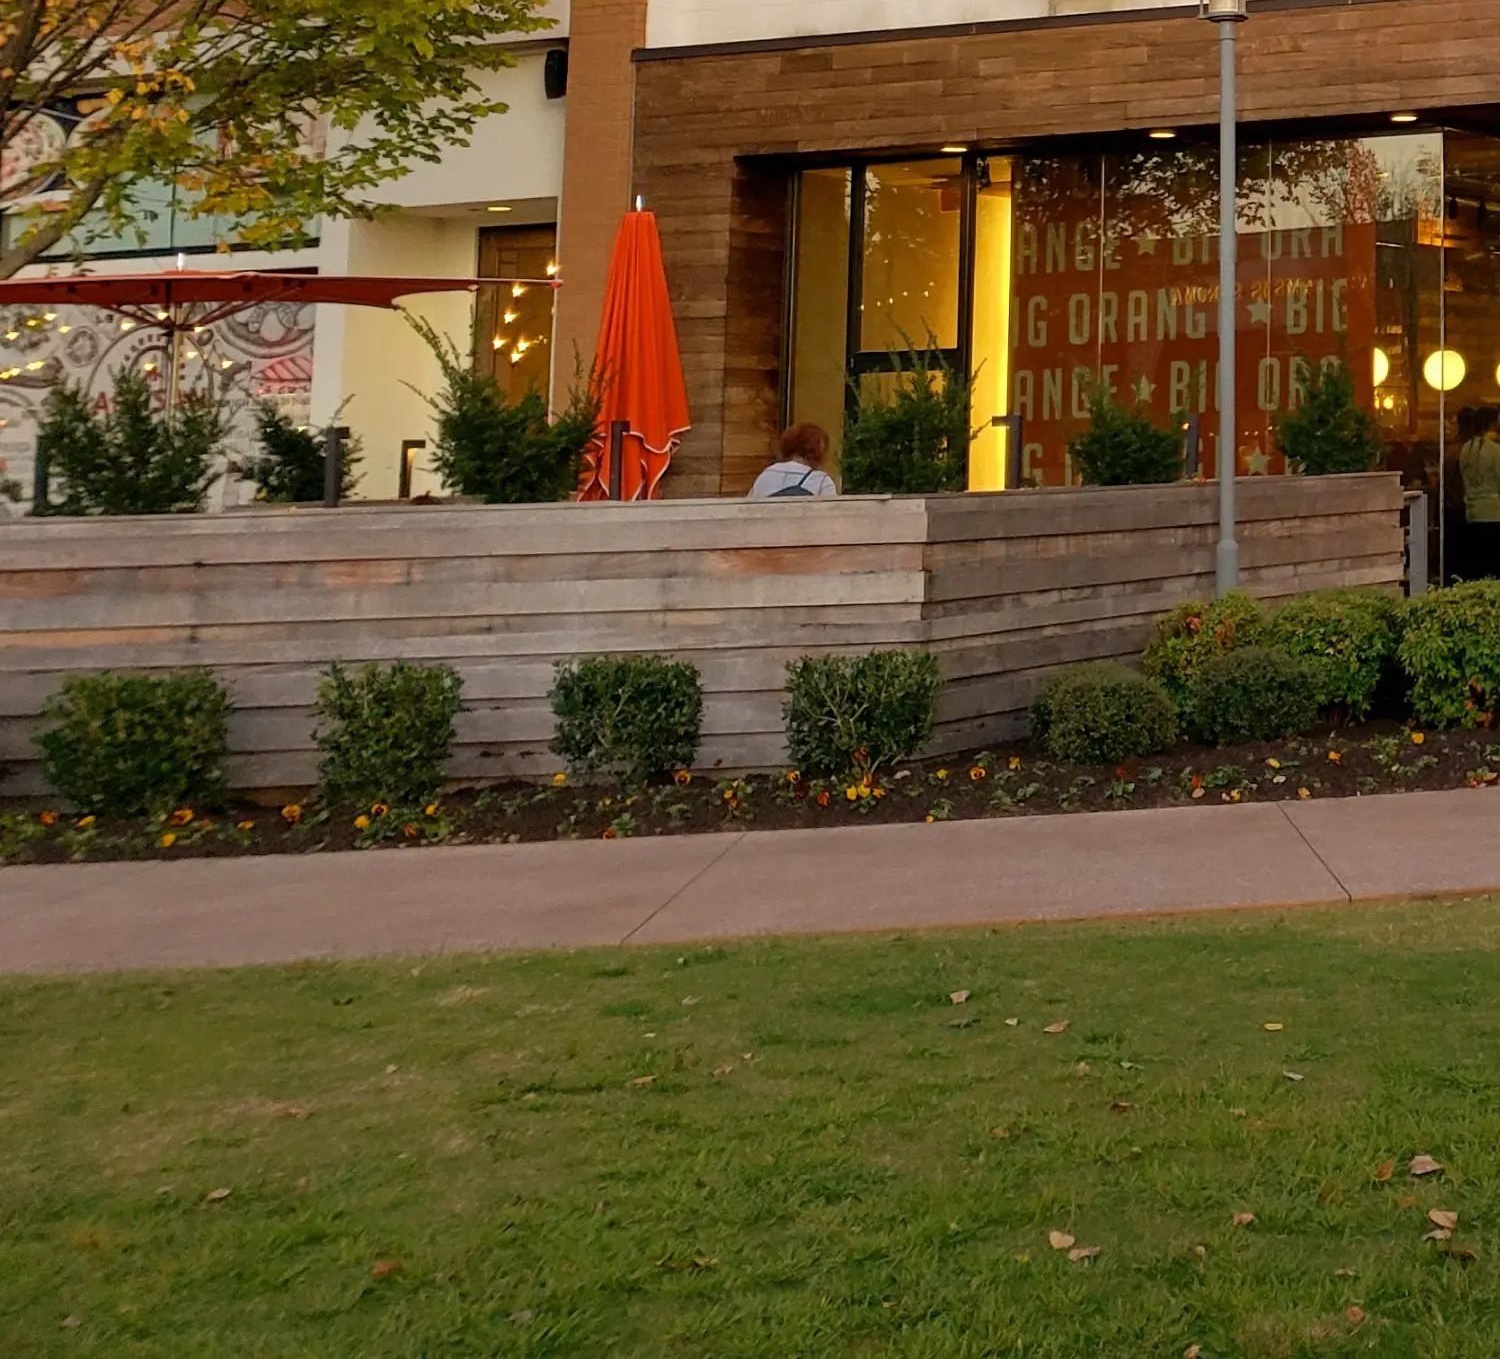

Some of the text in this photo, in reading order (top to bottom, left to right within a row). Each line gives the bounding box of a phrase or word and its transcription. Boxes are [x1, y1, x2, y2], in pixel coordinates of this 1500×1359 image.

[1172, 232, 1221, 267] BI
[1068, 282, 1221, 346] ORANG
[1170, 358, 1221, 415] BI
